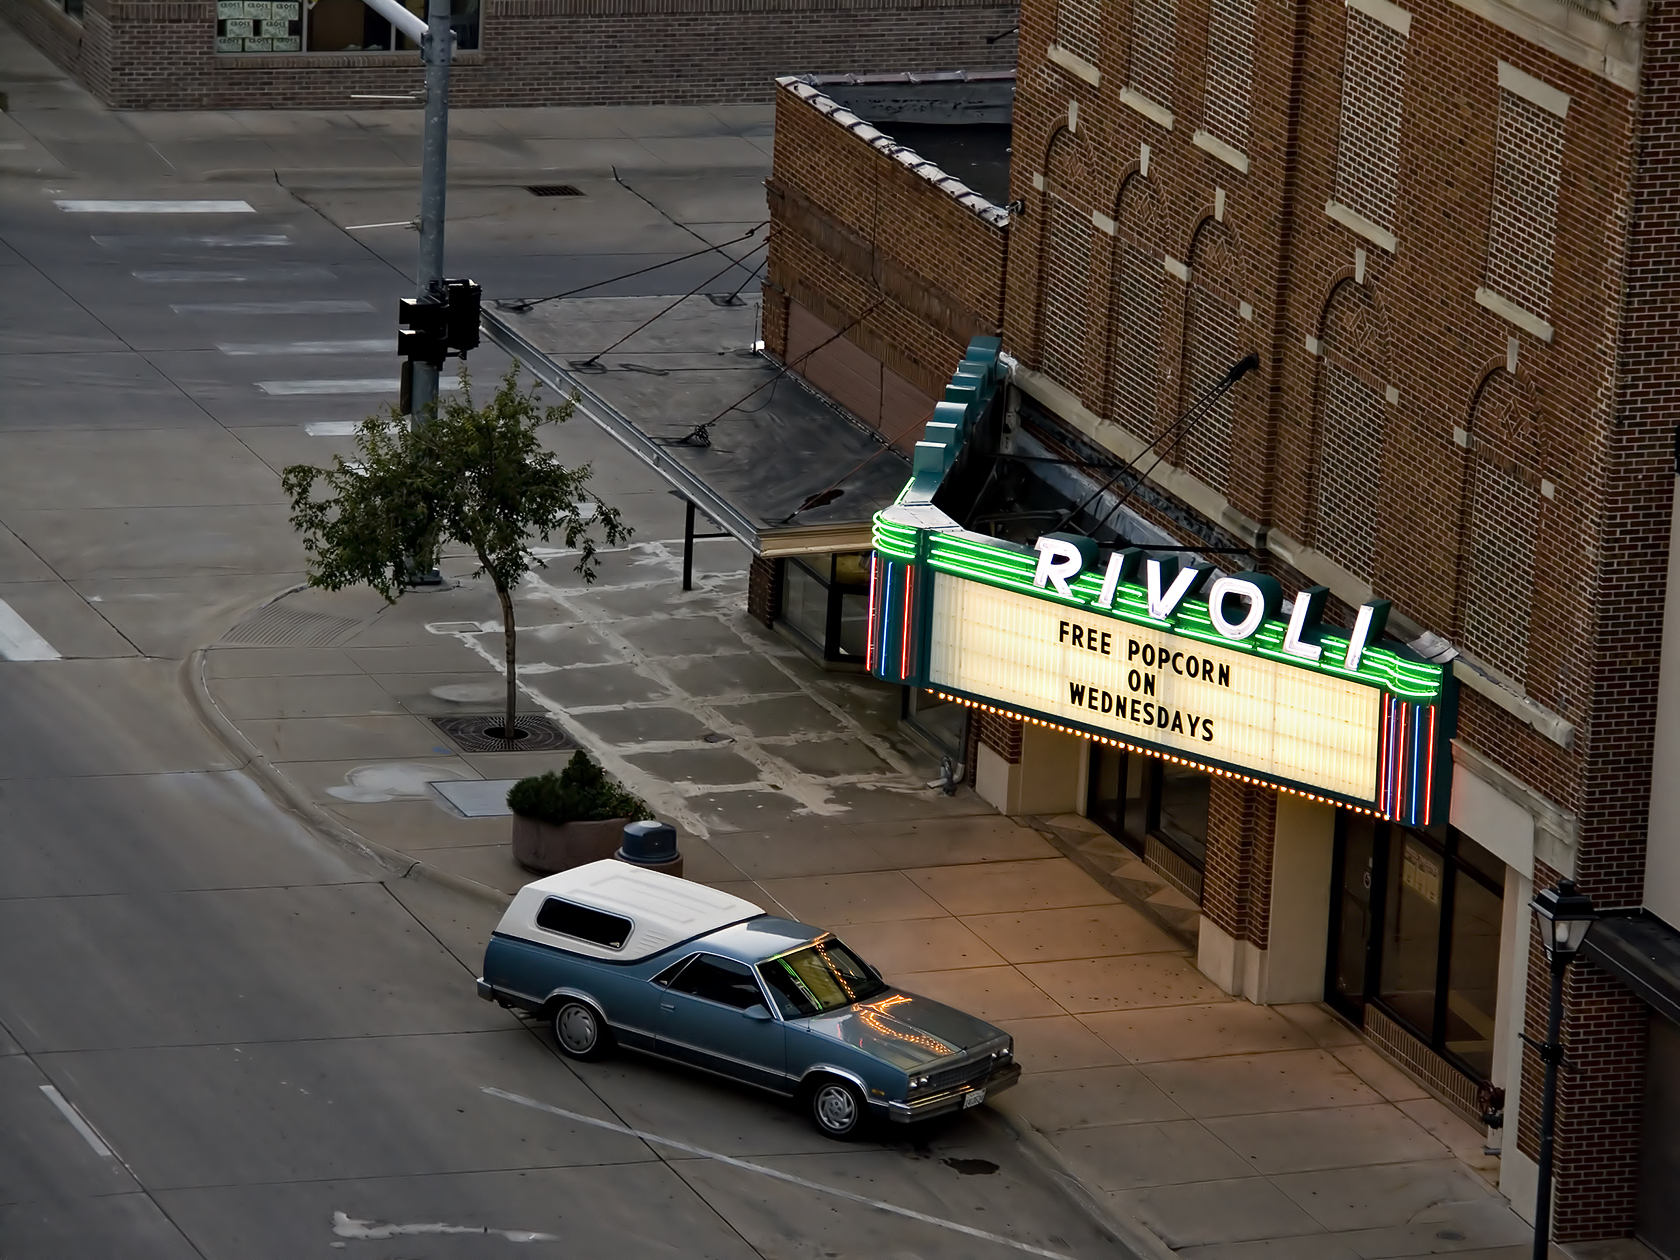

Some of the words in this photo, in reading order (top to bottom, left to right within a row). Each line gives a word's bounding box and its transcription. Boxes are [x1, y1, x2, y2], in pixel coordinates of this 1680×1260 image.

[1034, 535, 1376, 671] RIVOLI
[1059, 620, 1112, 655] FREE
[1128, 638, 1230, 687] POPCORN
[1128, 669, 1156, 697] ON
[1069, 681, 1214, 742] WEDNESDAYS
